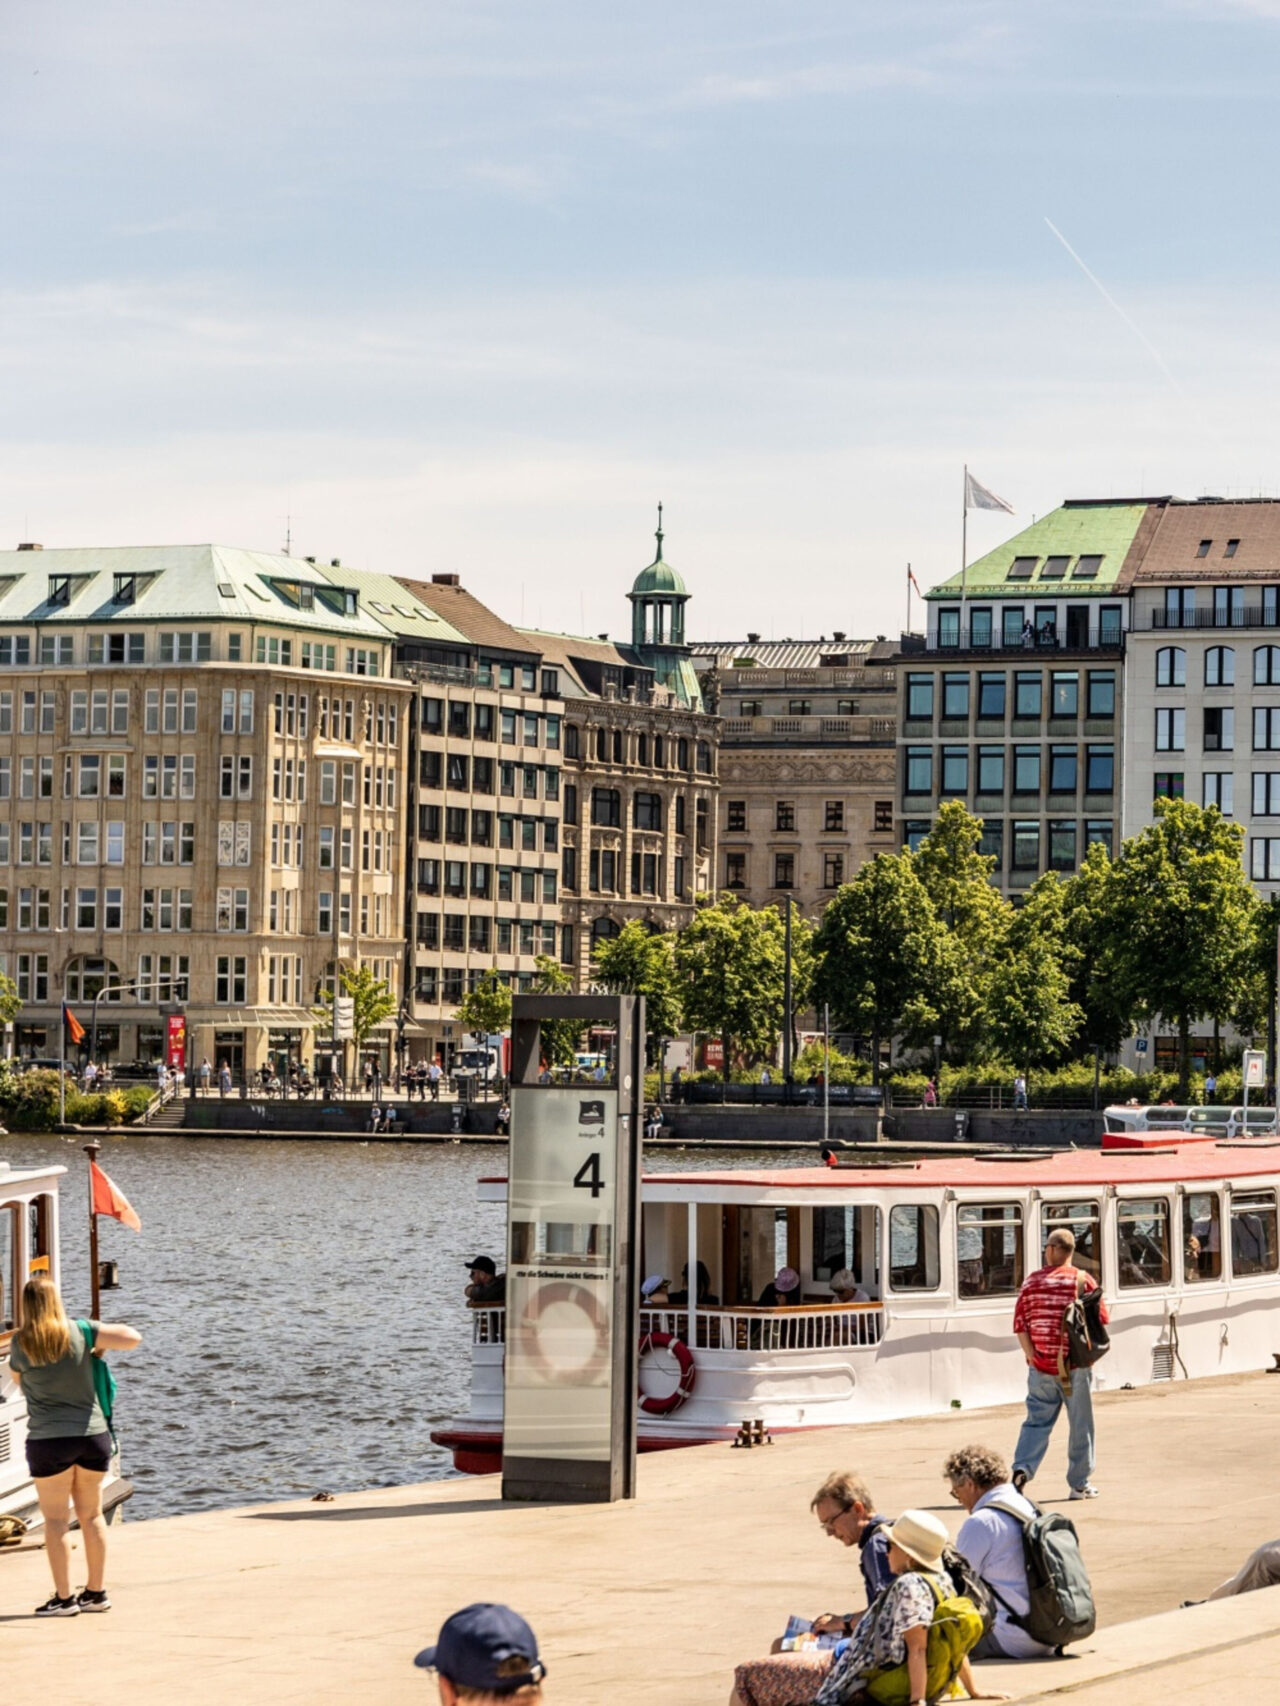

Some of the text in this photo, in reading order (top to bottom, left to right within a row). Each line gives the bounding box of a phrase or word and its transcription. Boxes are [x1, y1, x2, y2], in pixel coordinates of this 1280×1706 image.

[1138, 1041, 1145, 1049] P
[597, 1127, 605, 1138] 4
[573, 1152, 605, 1198] 4
